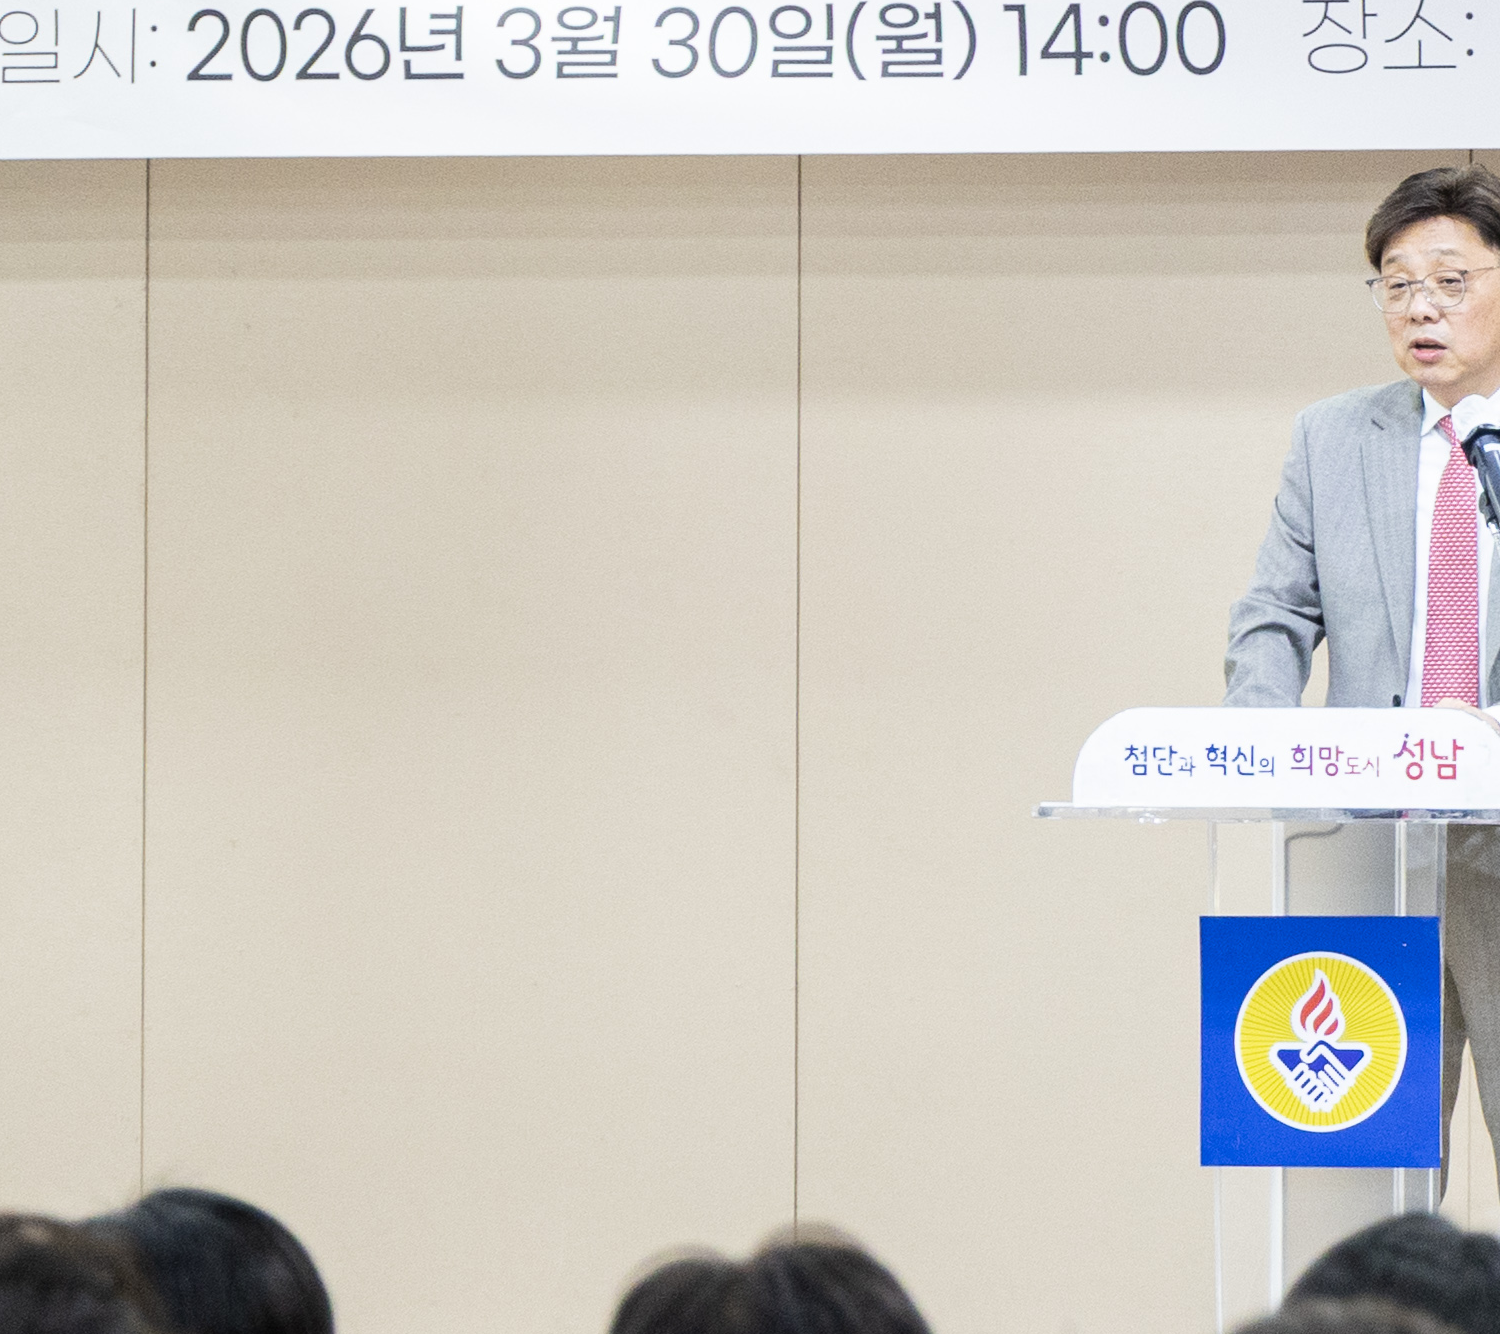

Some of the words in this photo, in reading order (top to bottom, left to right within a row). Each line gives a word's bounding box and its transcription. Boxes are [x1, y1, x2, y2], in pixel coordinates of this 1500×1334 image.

[186, 5, 465, 83] 2026년
[495, 5, 622, 80] 3월
[651, 0, 977, 81] 30일(월)
[1002, 0, 1227, 77] 14:00
[1124, 744, 1196, 777] 첨단과
[1204, 743, 1275, 777] 혁신의
[1393, 733, 1465, 781] 성남
